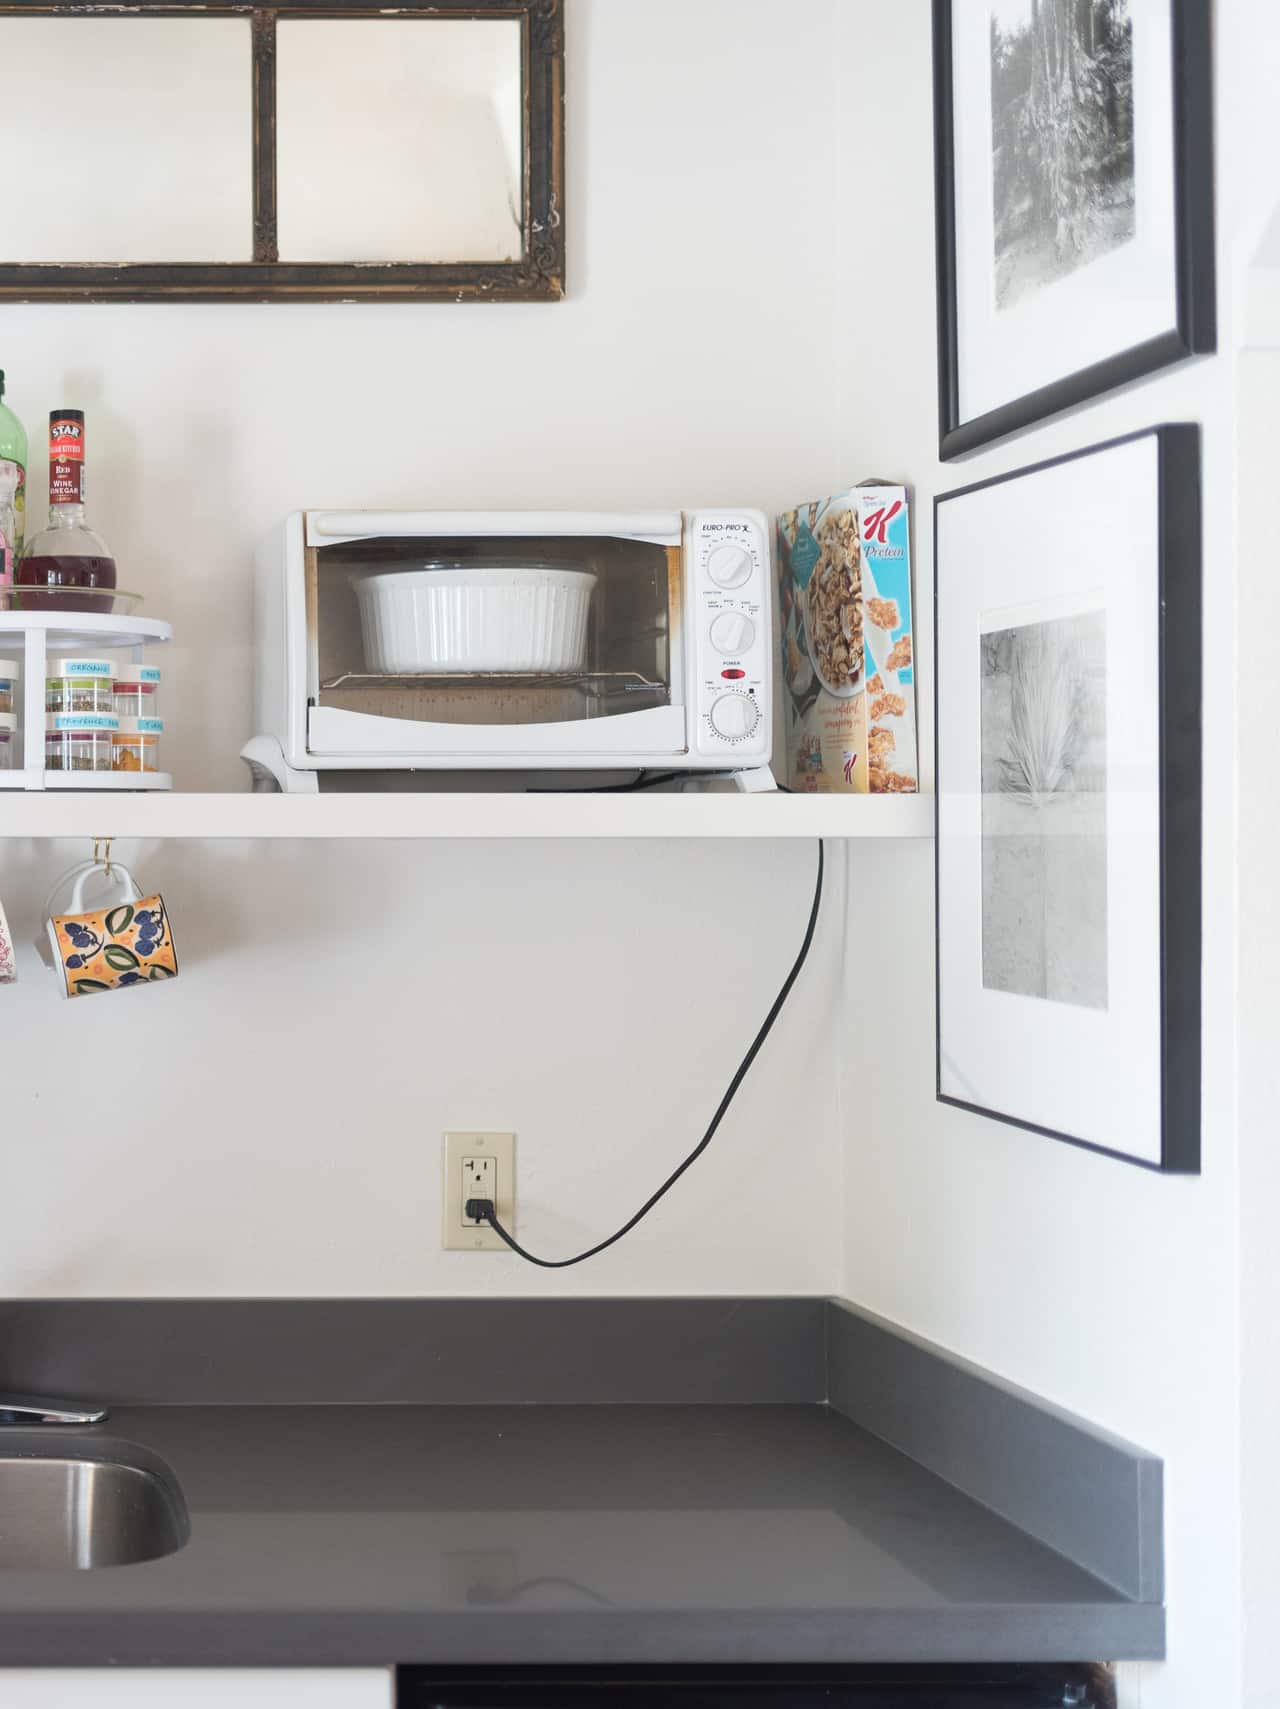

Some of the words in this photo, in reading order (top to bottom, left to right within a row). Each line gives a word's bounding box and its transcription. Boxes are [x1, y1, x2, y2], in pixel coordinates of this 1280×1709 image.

[52, 424, 80, 438] STAR
[863, 500, 902, 544] K
[863, 545, 905, 558] Protein
